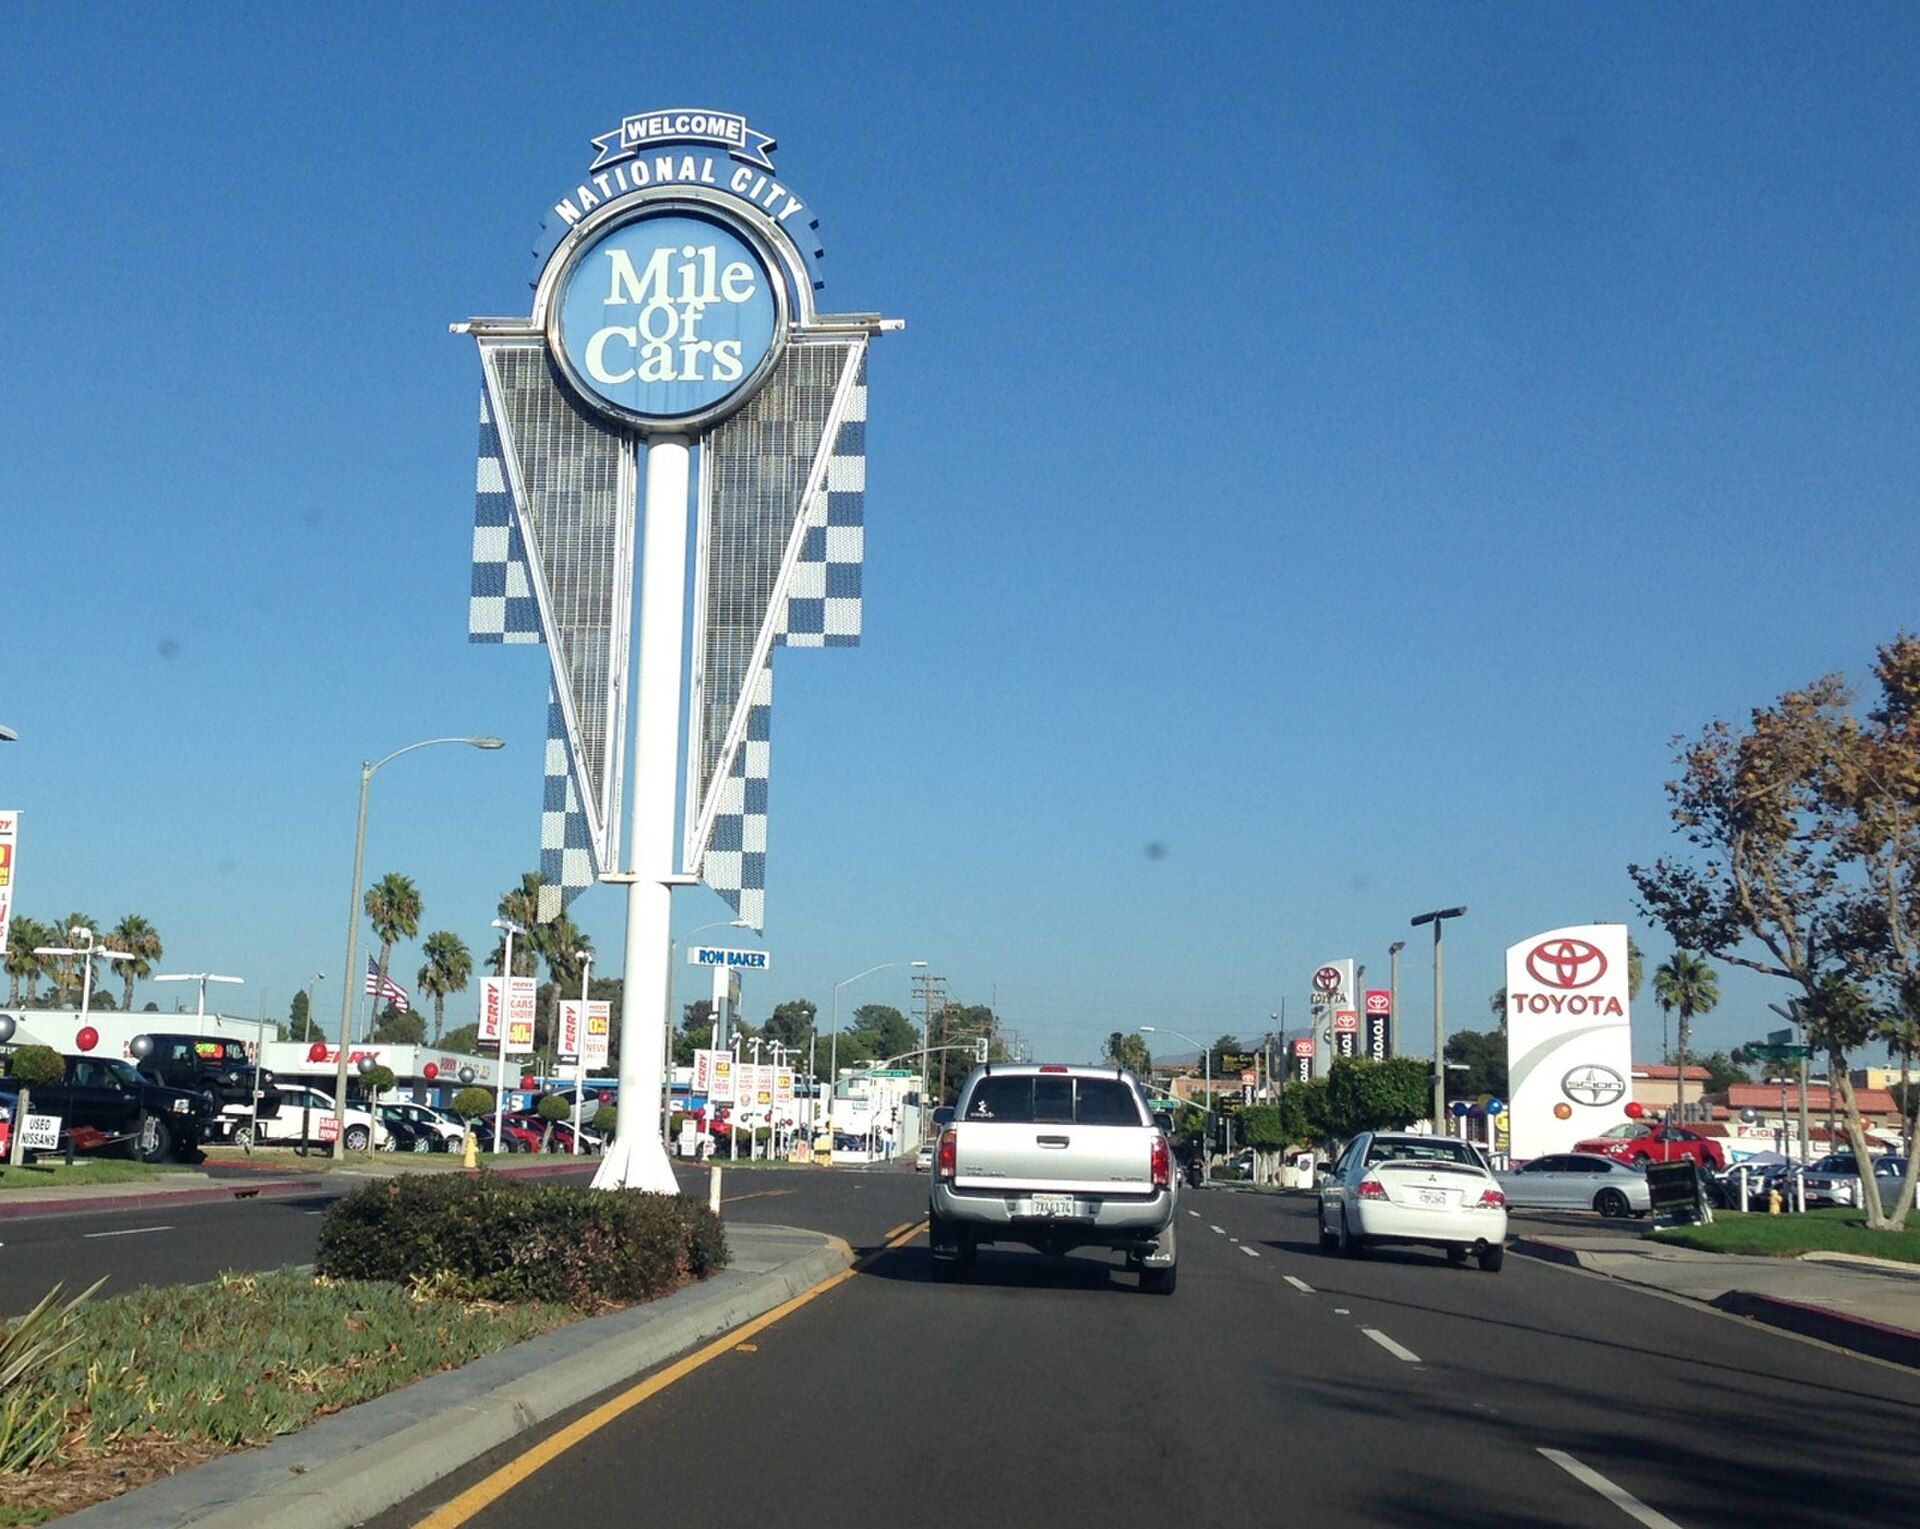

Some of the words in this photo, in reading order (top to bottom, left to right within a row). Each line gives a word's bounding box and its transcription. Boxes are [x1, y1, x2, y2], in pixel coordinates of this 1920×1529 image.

[627, 115, 741, 140] WELCOME
[555, 155, 715, 226] NATIONAL
[730, 166, 804, 221] CITY
[603, 245, 757, 306] Mile
[585, 325, 744, 385] Cars
[699, 949, 725, 964] RON
[727, 951, 766, 967] BAKER
[486, 983, 499, 1037] PERRY
[1511, 993, 1624, 1016] TOYOTA
[565, 1006, 576, 1052] PERRY
[21, 1132, 56, 1146] NISSANS
[29, 1118, 51, 1131] USED
